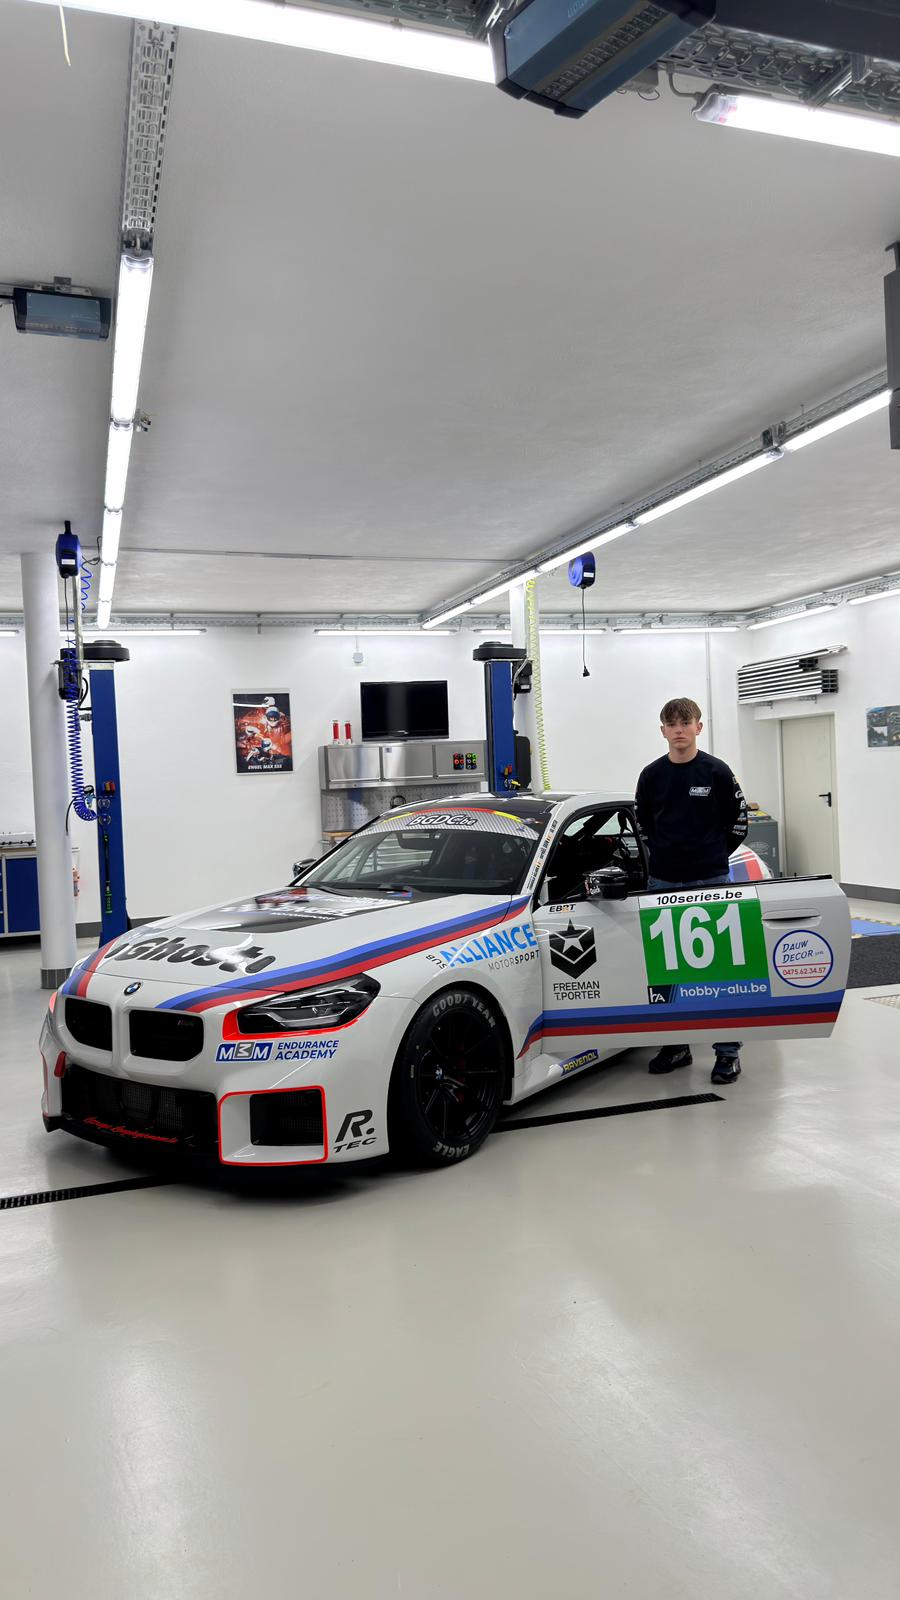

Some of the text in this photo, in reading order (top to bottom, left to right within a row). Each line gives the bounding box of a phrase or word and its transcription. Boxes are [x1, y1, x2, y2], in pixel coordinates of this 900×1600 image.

[407, 814, 477, 826] BGDC.be
[656, 890, 743, 905] 100series.be
[649, 903, 746, 971] 161
[440, 924, 538, 968] ALLIANCE
[782, 940, 808, 953] DAUW
[488, 950, 540, 971] MOTORSPORT
[782, 949, 814, 964] DECOR
[553, 981, 600, 992] FREEMAN
[680, 982, 768, 998] hobby-alu.be
[277, 1040, 339, 1050] ENDURANCE
[275, 1049, 337, 1061] ACADEMY
[333, 1137, 377, 1153] TEC
[432, 1141, 470, 1158] EAGLE
